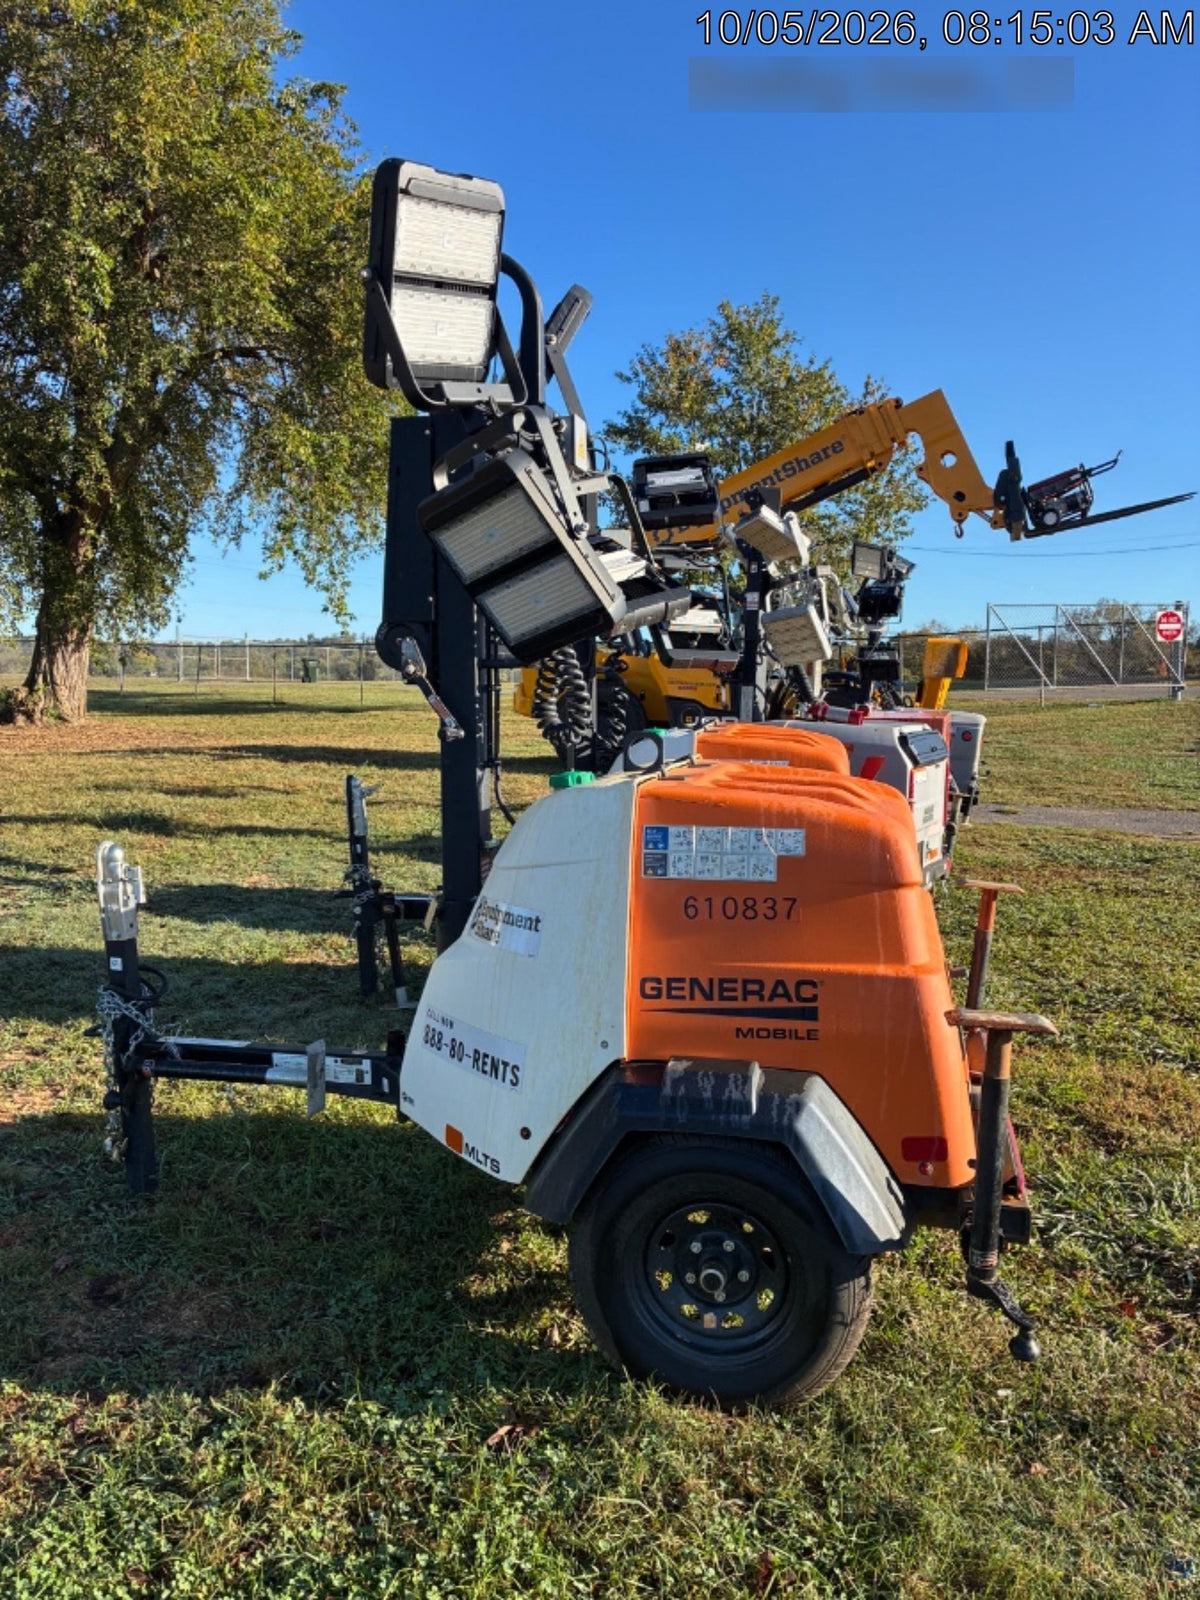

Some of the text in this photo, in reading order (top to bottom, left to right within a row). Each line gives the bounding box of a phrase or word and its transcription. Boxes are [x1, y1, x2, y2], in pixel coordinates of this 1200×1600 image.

[685, 896, 796, 920] 610837
[640, 977, 819, 1003] GENERAC
[736, 1027, 819, 1041] MOBILE
[424, 1024, 520, 1086] 888-80-RENTS
[464, 1143, 501, 1174] MLTS
